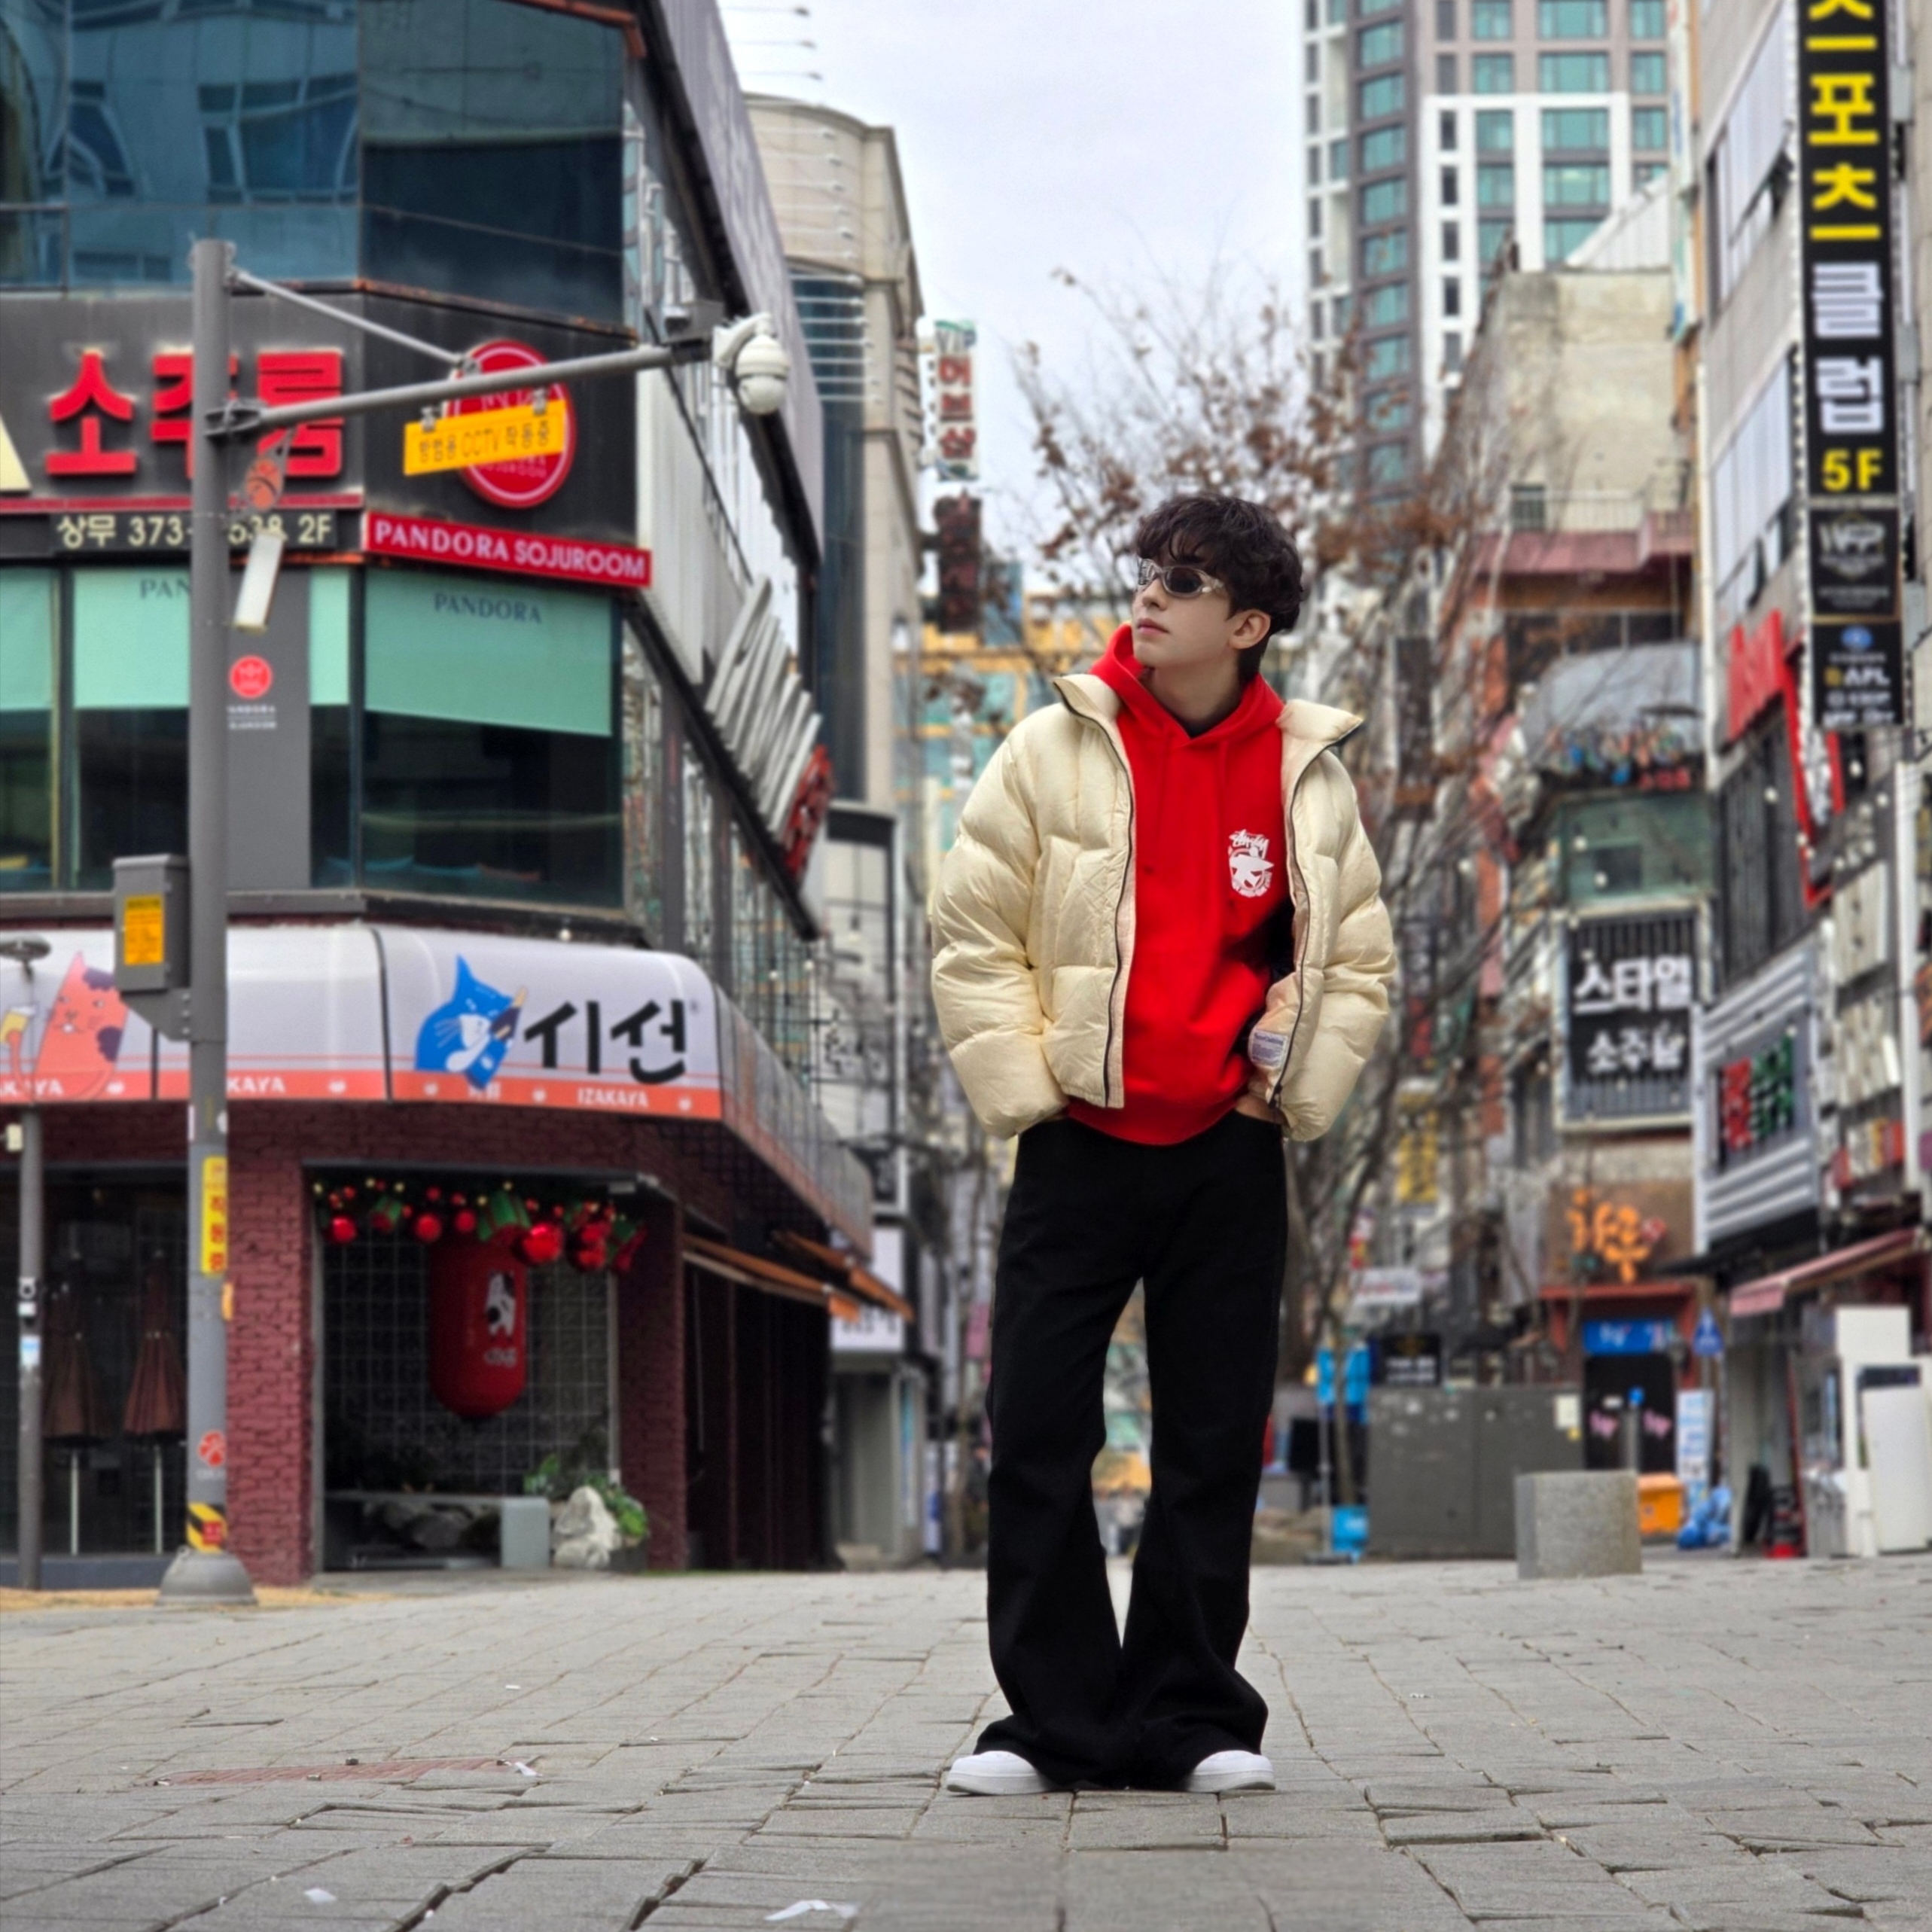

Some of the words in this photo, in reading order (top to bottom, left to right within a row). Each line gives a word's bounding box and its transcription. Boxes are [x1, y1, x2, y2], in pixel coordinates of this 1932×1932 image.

[462, 426, 502, 458] CCTV
[1822, 447, 1882, 491] 5F
[57, 513, 116, 549] 상무
[298, 514, 332, 544] 2F
[376, 520, 510, 562] PANDORA
[513, 538, 647, 579] SOJUROOM
[434, 592, 543, 625] PANDORA
[1574, 954, 1693, 1013] 스타일
[577, 1087, 649, 1107] IZAKAYA
